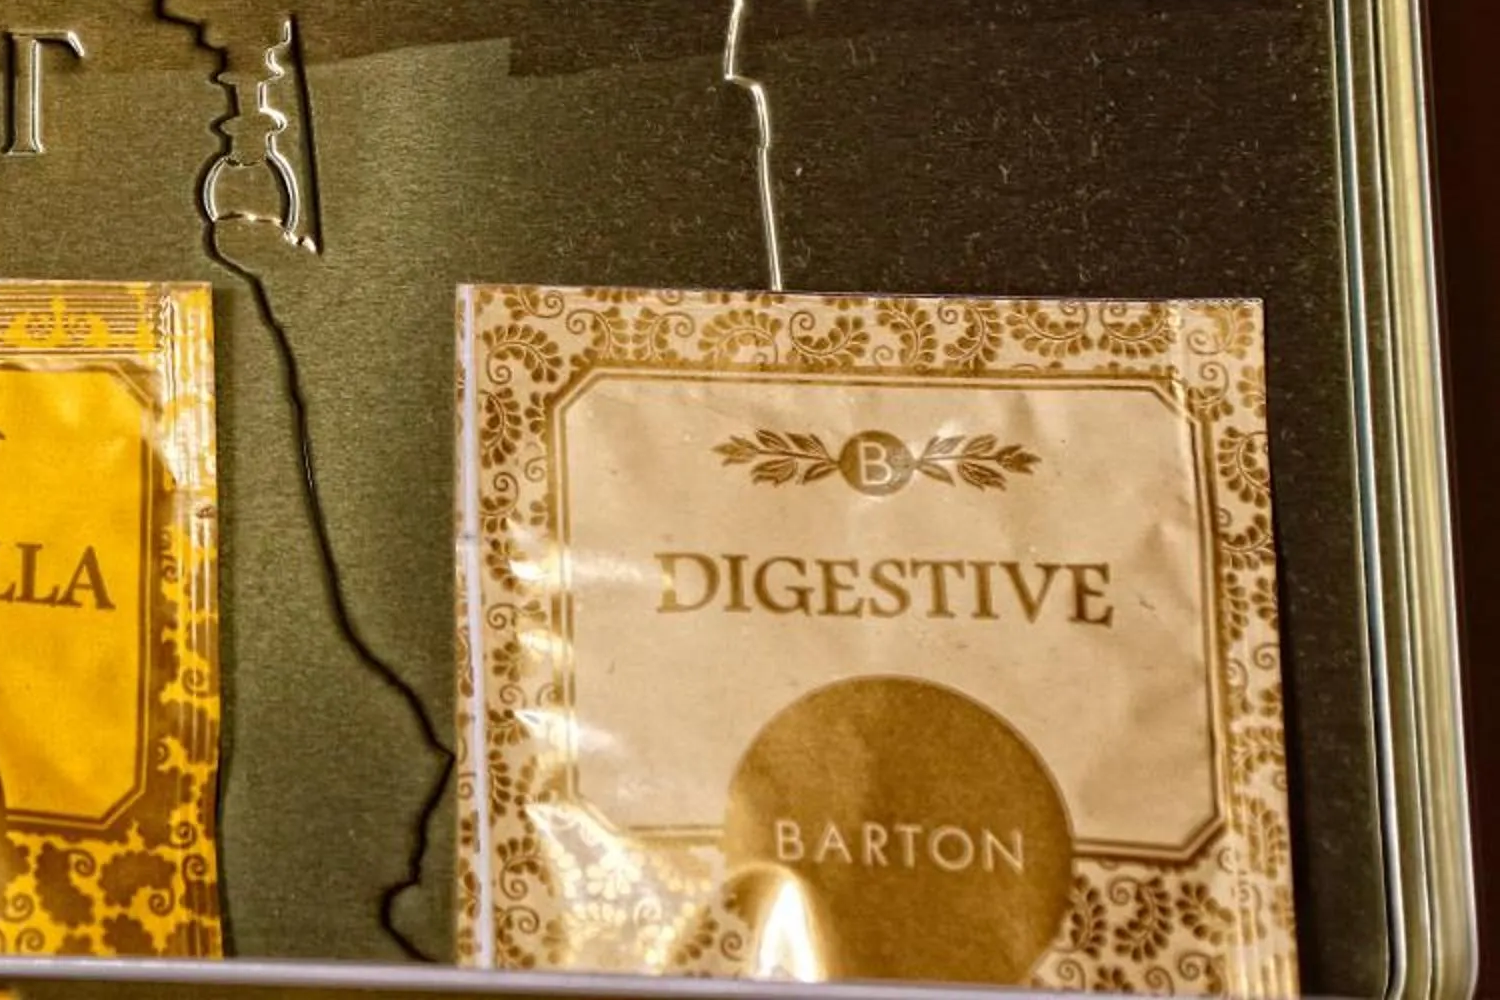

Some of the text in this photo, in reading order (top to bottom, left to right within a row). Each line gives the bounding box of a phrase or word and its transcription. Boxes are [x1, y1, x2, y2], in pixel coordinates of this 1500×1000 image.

[860, 441, 894, 485] B
[654, 551, 1115, 629] DIGESTIVE
[775, 820, 1026, 874] BARTON
